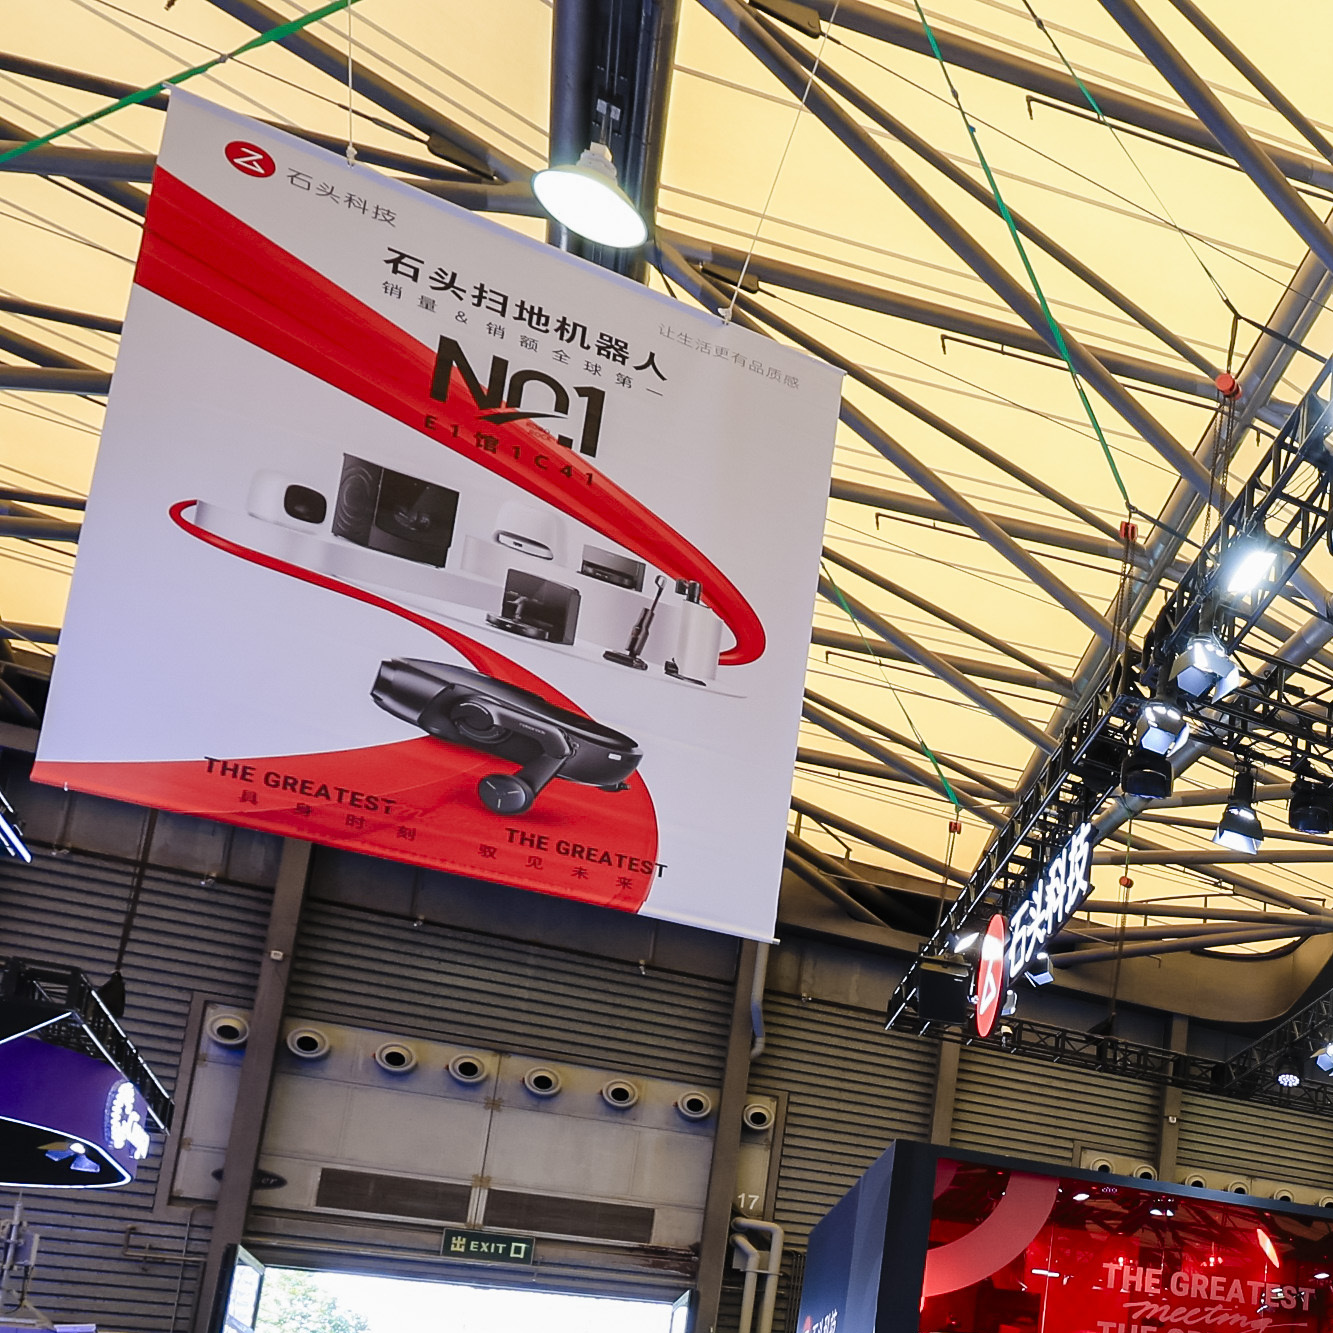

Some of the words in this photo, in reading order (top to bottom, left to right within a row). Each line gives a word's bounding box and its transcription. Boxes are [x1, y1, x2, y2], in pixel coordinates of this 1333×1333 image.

[287, 168, 397, 227] 石头科技
[382, 280, 664, 396] 销量&销额全球第一
[383, 247, 668, 382] 石头扫地机器人
[657, 322, 801, 391] 让生活更有品质感
[204, 757, 255, 783] THE
[263, 770, 396, 815] GREATEST
[478, 843, 634, 890] 驭见未来
[504, 827, 550, 851] THE
[555, 839, 668, 878] GREATEST
[1008, 822, 1092, 978] 石头科技
[737, 1193, 760, 1210] 17
[451, 1235, 466, 1253] 出
[470, 1240, 507, 1255] EXIT
[510, 1242, 526, 1259] 口
[1102, 1262, 1163, 1295] THE
[1169, 1271, 1316, 1312] GREATEST
